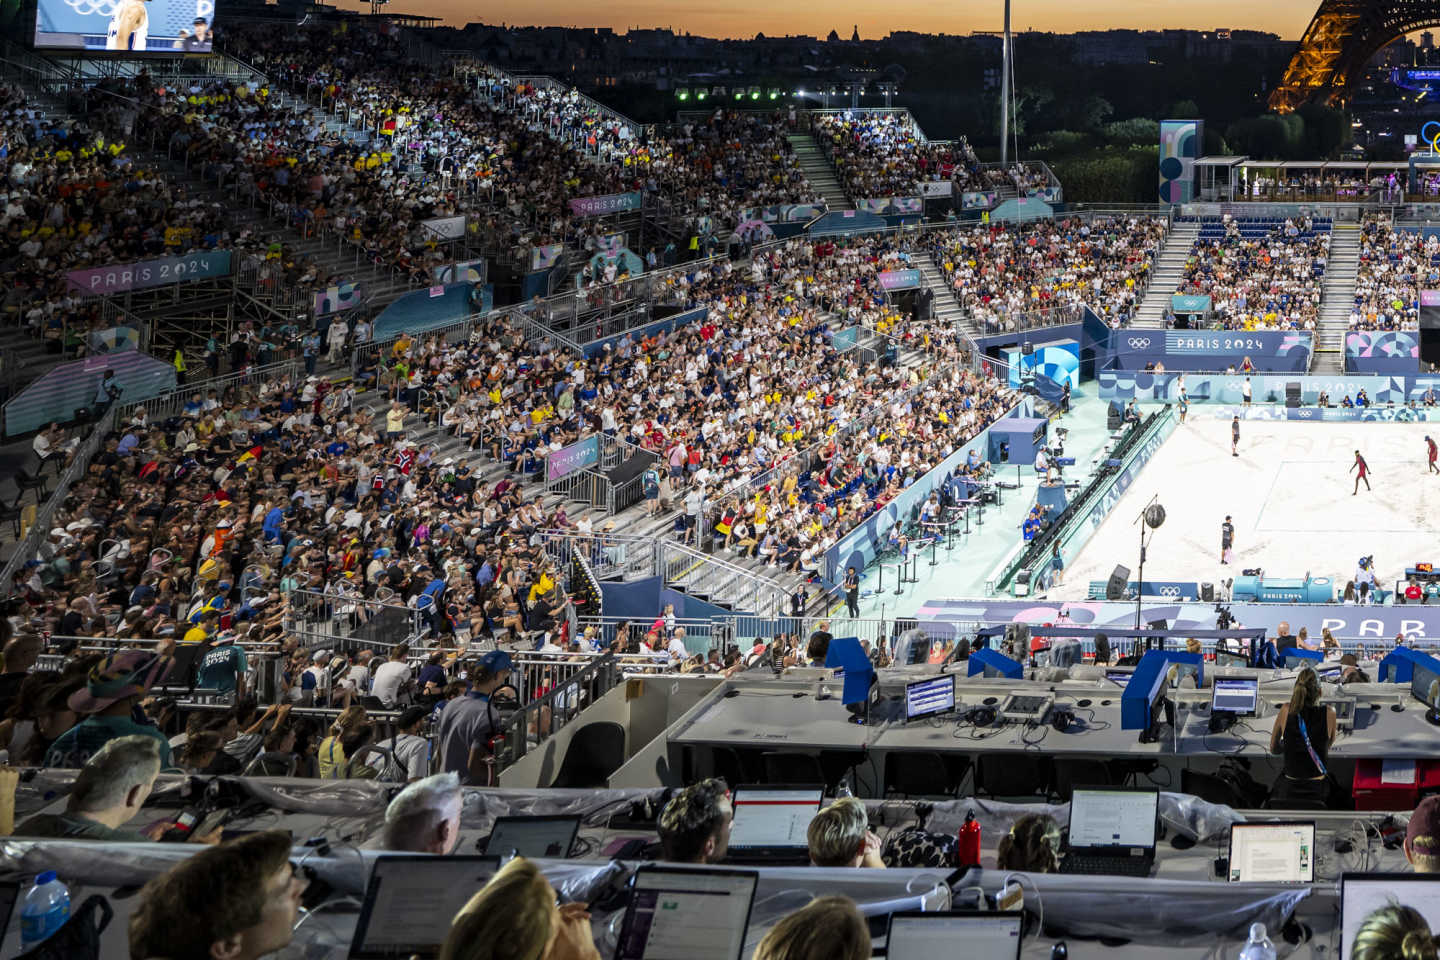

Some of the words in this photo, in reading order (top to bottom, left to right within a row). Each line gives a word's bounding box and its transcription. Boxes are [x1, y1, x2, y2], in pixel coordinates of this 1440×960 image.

[91, 268, 152, 289] PARIS
[160, 260, 209, 278] 2024
[1177, 339, 1219, 349] PARIS
[1224, 339, 1263, 350] 2024
